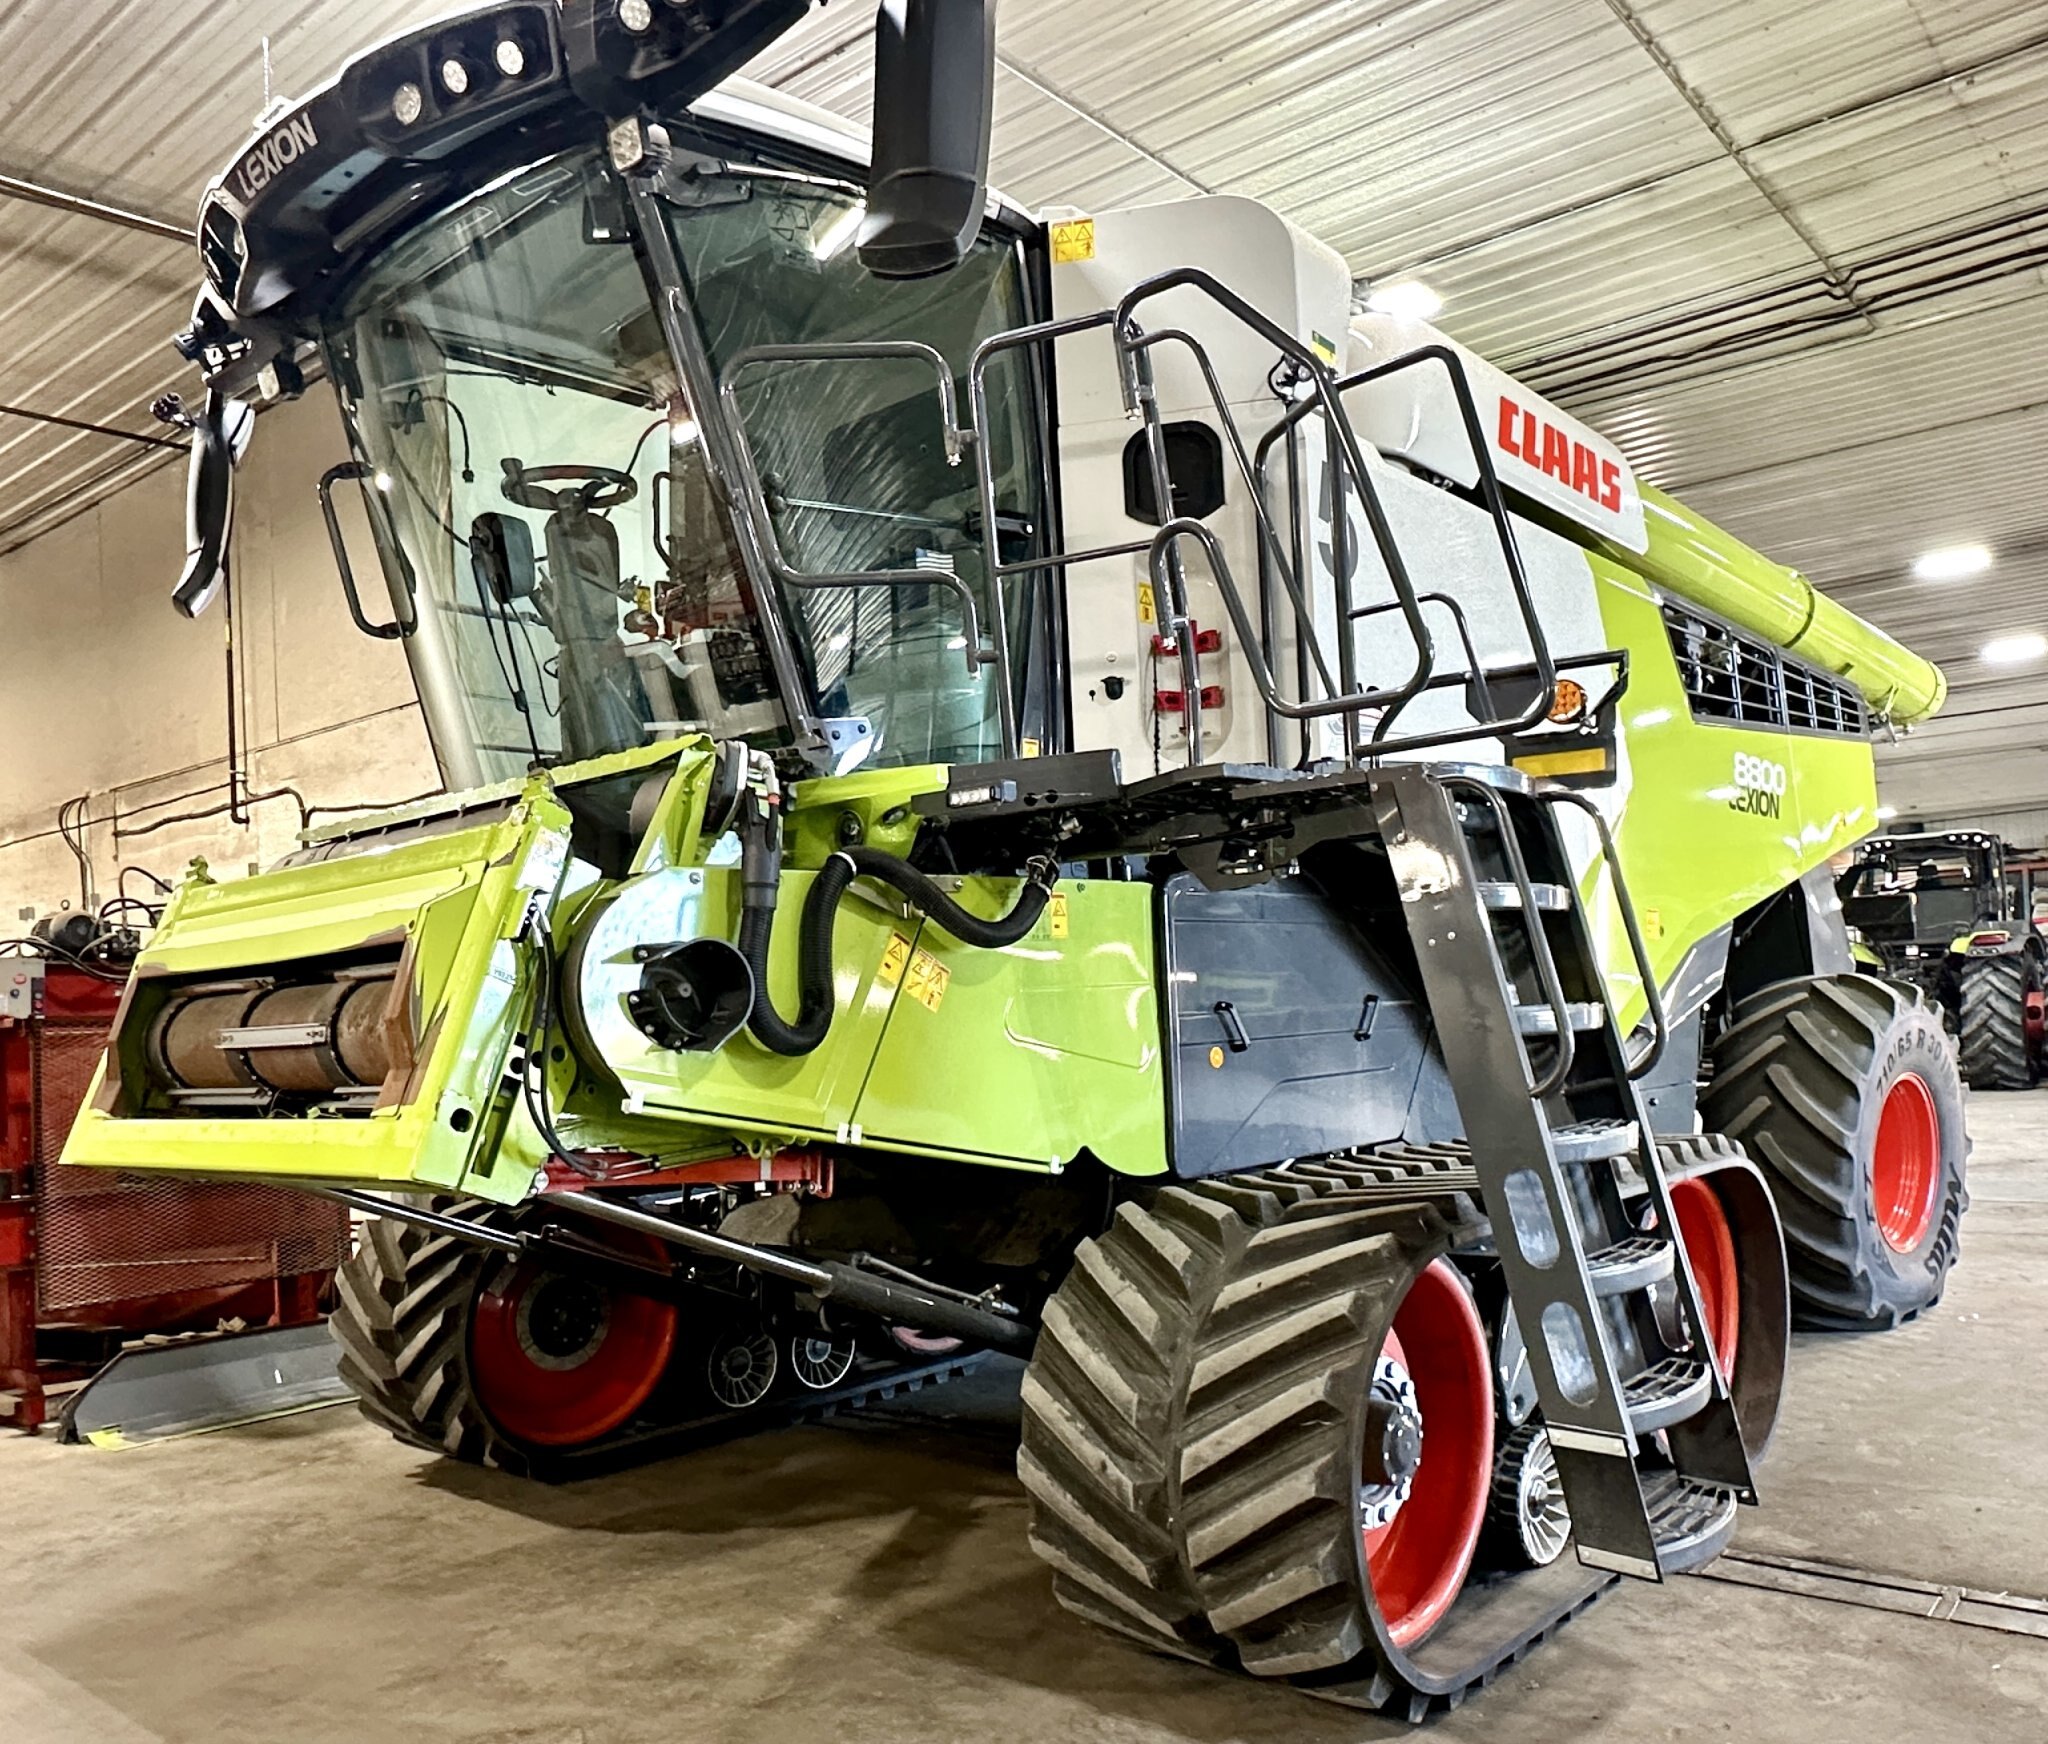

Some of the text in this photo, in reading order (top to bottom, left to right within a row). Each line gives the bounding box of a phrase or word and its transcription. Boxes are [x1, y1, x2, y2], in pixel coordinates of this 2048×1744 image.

[236, 111, 319, 200] LEXION
[1498, 395, 1622, 514] CLAAS
[1733, 751, 1787, 797] 8800
